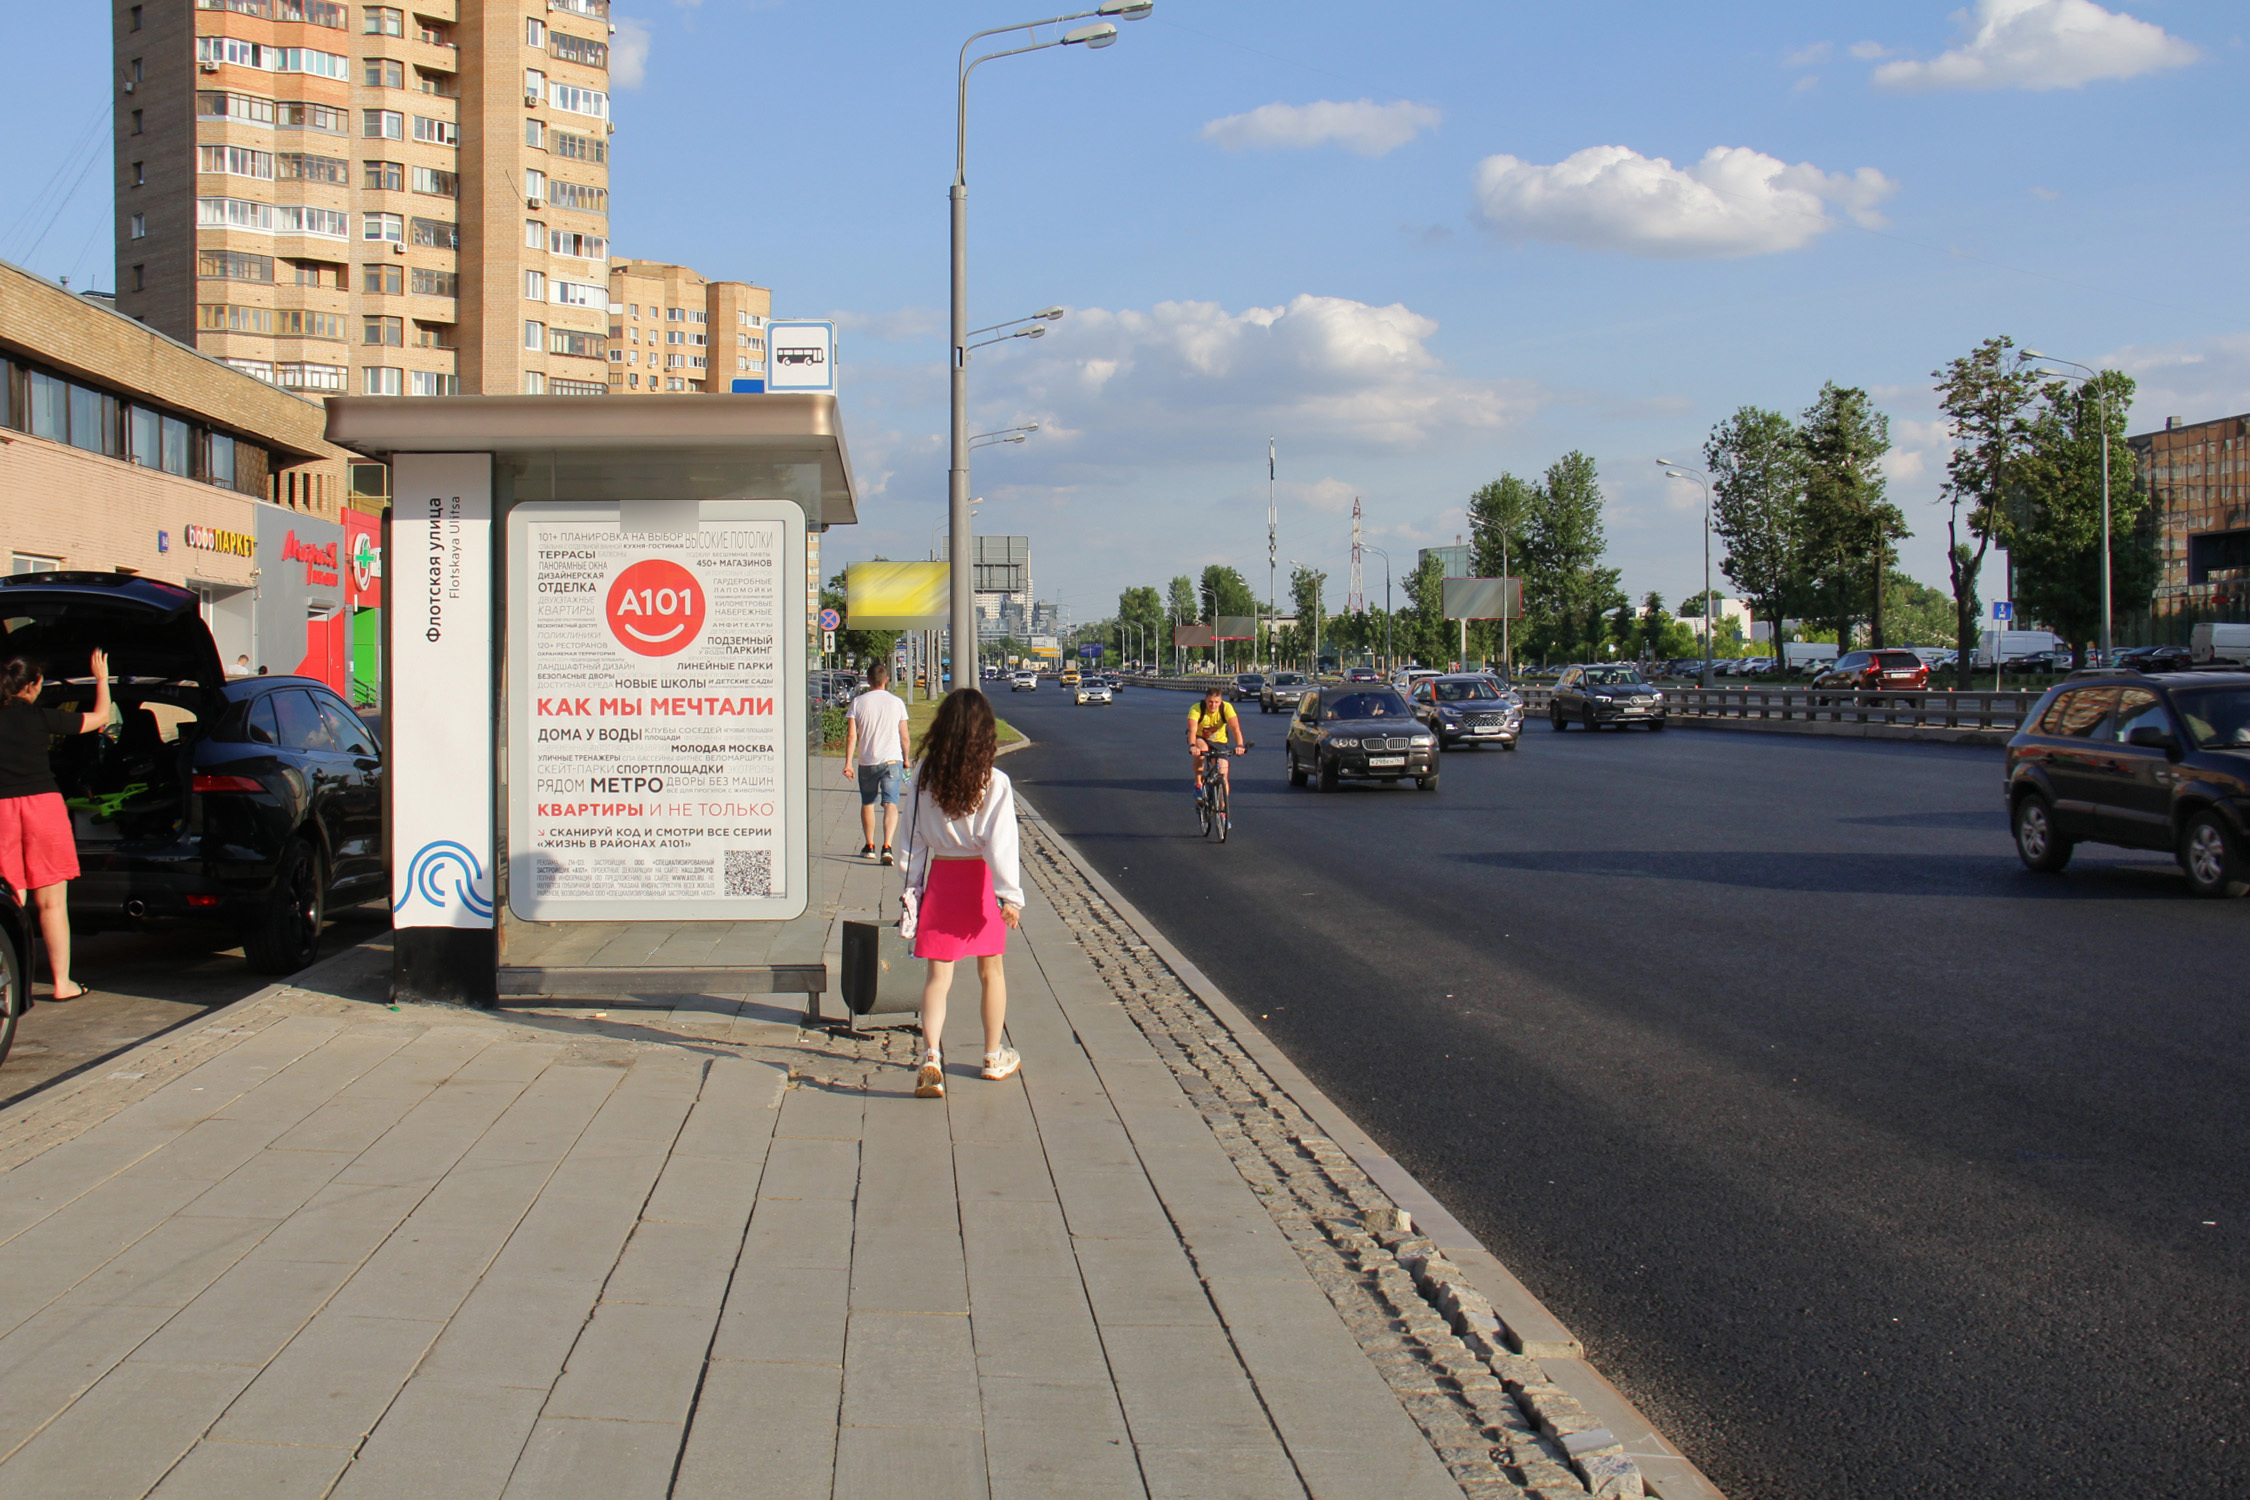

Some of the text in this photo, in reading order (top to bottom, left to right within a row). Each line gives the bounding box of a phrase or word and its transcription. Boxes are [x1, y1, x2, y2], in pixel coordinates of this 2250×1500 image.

[539, 533, 684, 541] 101+ ПЛАНИРОВКА НА ВЫБОР
[686, 532, 773, 549] ВЫСОКИЕ ПОТОЛКИ
[449, 495, 462, 599] Flotskaya Ulitsa
[539, 551, 596, 559] ТЕРРАСЫ
[539, 561, 608, 570] ПАНОРАМНЫЕ ОКНА
[696, 559, 717, 567] 450+
[426, 497, 444, 643] Флотская улица
[538, 572, 604, 580] ДИЗАЙНЕРСКАЯ
[713, 578, 772, 586] ГАРДЕРОБНЫЕ
[538, 583, 596, 594] ОТДЕЛКА
[538, 596, 595, 604] ДВУХЭТАЖНЫЕ
[538, 606, 595, 616] КВАРТИРЫ
[715, 608, 772, 616] НАБЕРЕЖНЫЕ
[708, 635, 772, 646] ПОДЗЕМНЫЙ
[726, 646, 772, 654] ПАРКИНГ
[537, 662, 635, 670] ЛАНДШАФТНЫЙ ДИЗАЙН
[677, 660, 772, 670] ЛИНЕЙНЫЕ ПАРКИ
[615, 679, 706, 689] НОВЫЕ ШКОЛЫ
[537, 698, 773, 716] КАК МЫ МЕЧТАЛИ
[538, 728, 642, 742] ДОМА У ВОДЫ
[671, 745, 725, 753] МОЛОДАЯ
[637, 754, 674, 762] БАССЕЙНЫ
[705, 754, 774, 762] ВЕЛОМАРШРУТЫ
[537, 763, 614, 774] СКЕЙТ-ПАРКИ
[617, 765, 723, 775] СПОРТПЛОЩАДКИ
[538, 778, 663, 794] РЯДОМ МЕТРО
[667, 777, 774, 787] ДВОРЫ БЕЗ МАШИН
[538, 804, 643, 816] КВАРТИРЫ
[650, 804, 661, 816] И
[669, 804, 693, 816] НЕ
[550, 826, 772, 838] СКАНИРУЙ КОД И СМОТРИ ВСЕ СЕРИИ
[537, 839, 586, 848] «ЖИЗНЬ
[590, 840, 596, 848] В
[600, 838, 656, 848] РАЙОНАХ
